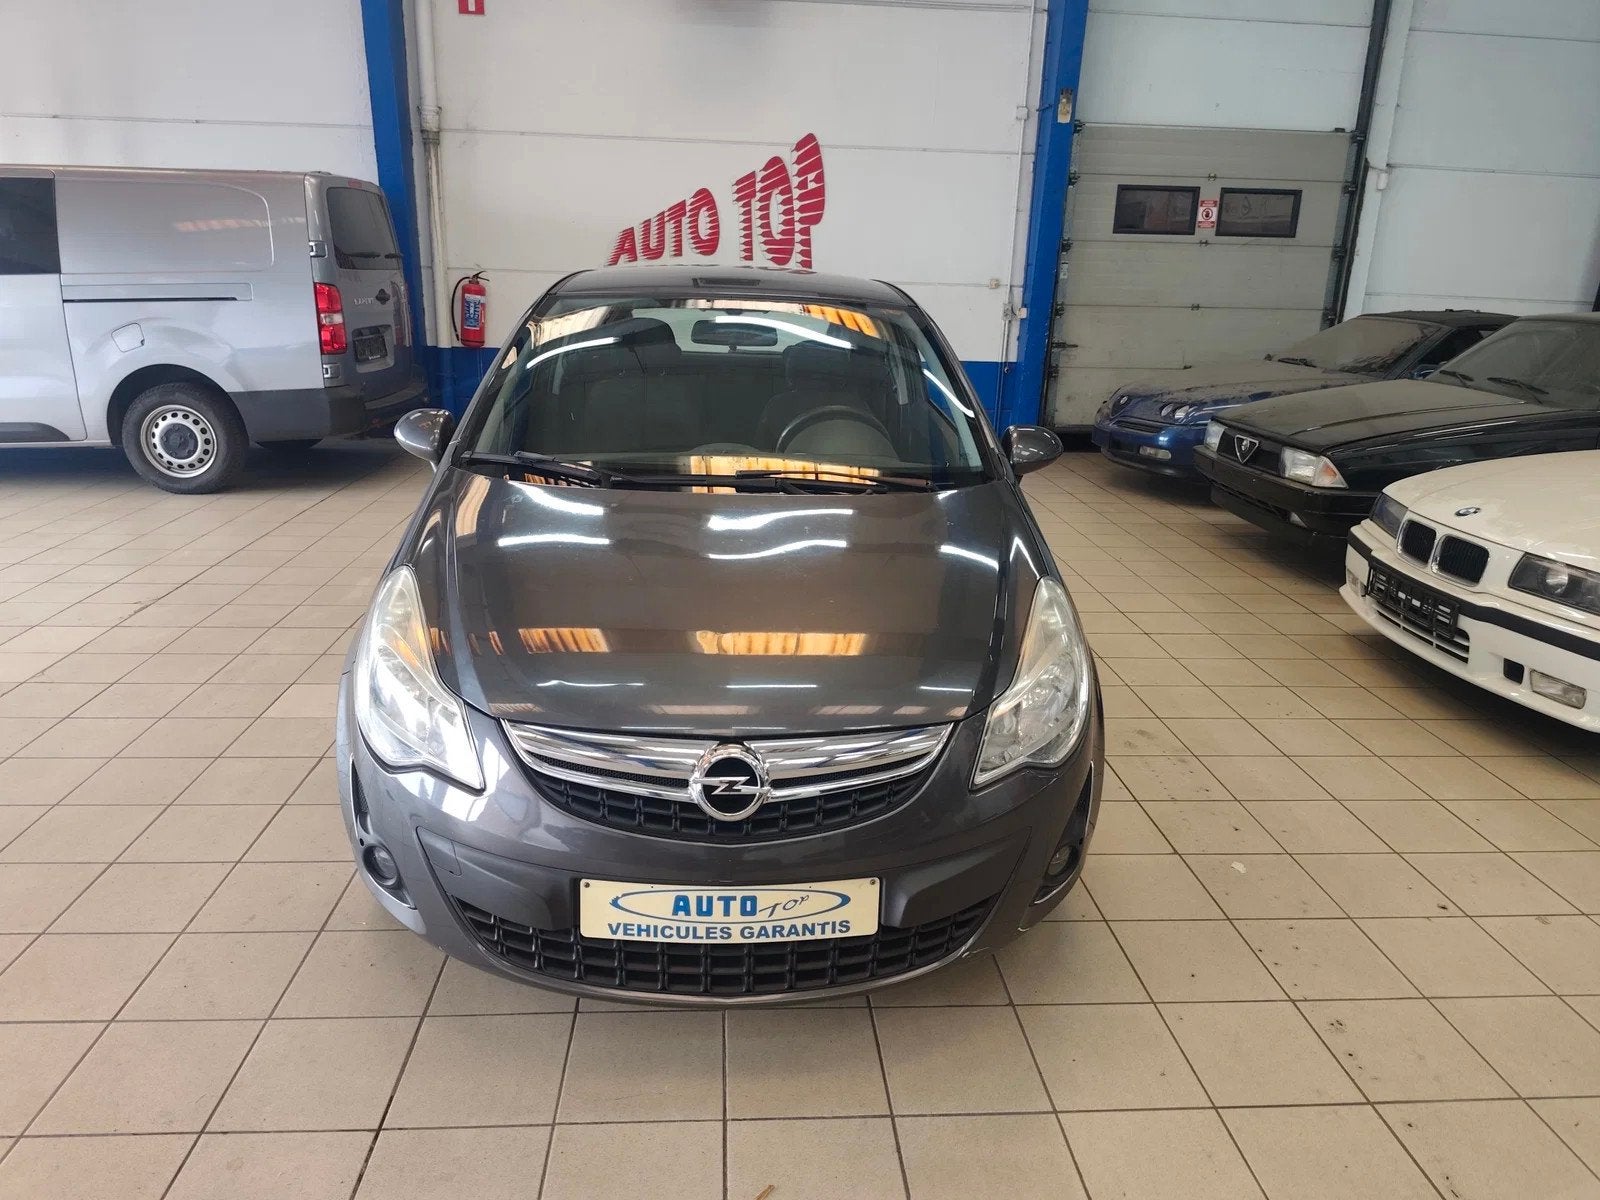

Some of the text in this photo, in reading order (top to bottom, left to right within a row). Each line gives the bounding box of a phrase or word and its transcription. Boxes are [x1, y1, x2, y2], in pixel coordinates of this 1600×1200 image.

[604, 133, 825, 269] AUTO TOP
[671, 895, 758, 917] AUTO
[607, 919, 851, 940] VEHICULES GARANTIS
